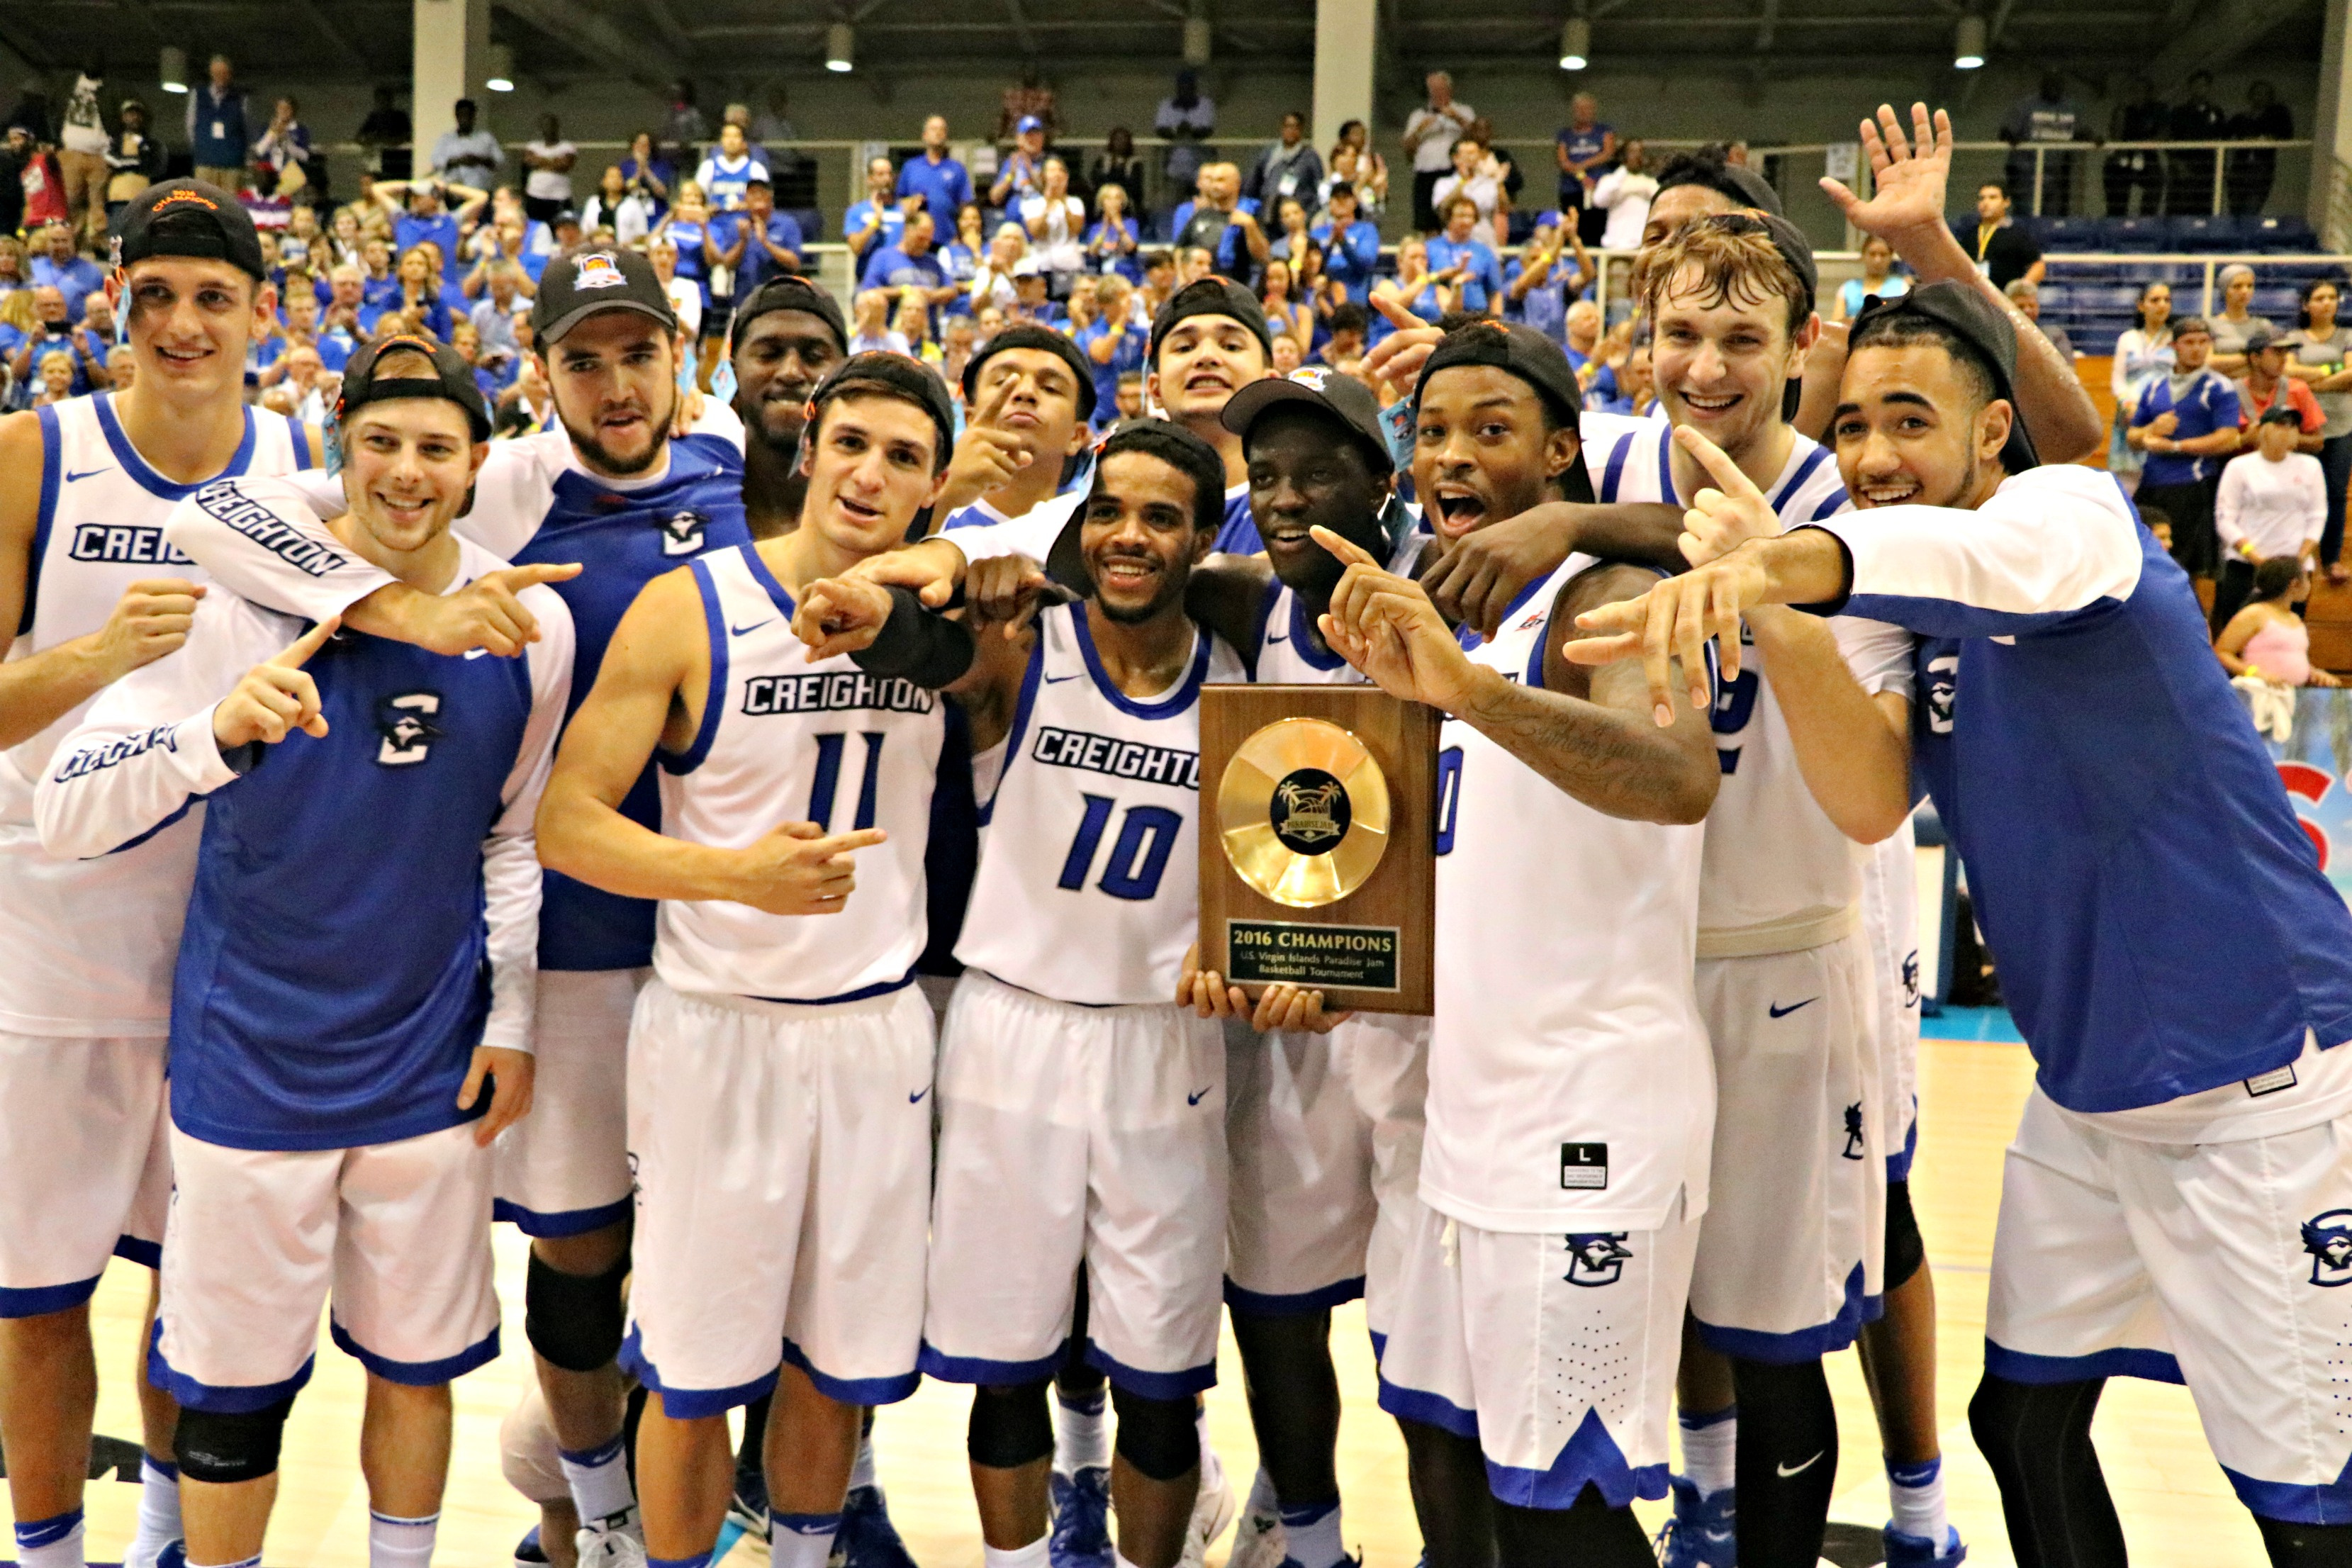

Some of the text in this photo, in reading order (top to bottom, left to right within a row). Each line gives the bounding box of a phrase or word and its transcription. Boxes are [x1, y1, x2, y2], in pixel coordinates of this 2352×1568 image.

[807, 732, 886, 832] 11
[1057, 791, 1183, 899] 10
[1234, 930, 1391, 952] 2016 CHAMPIONS
[1259, 951, 1285, 964] Virgin
[1289, 953, 1320, 964] Islands
[1324, 955, 1362, 966] Paradise
[1259, 964, 1364, 979] Basketball Tournament
[1579, 1147, 1591, 1162] L
